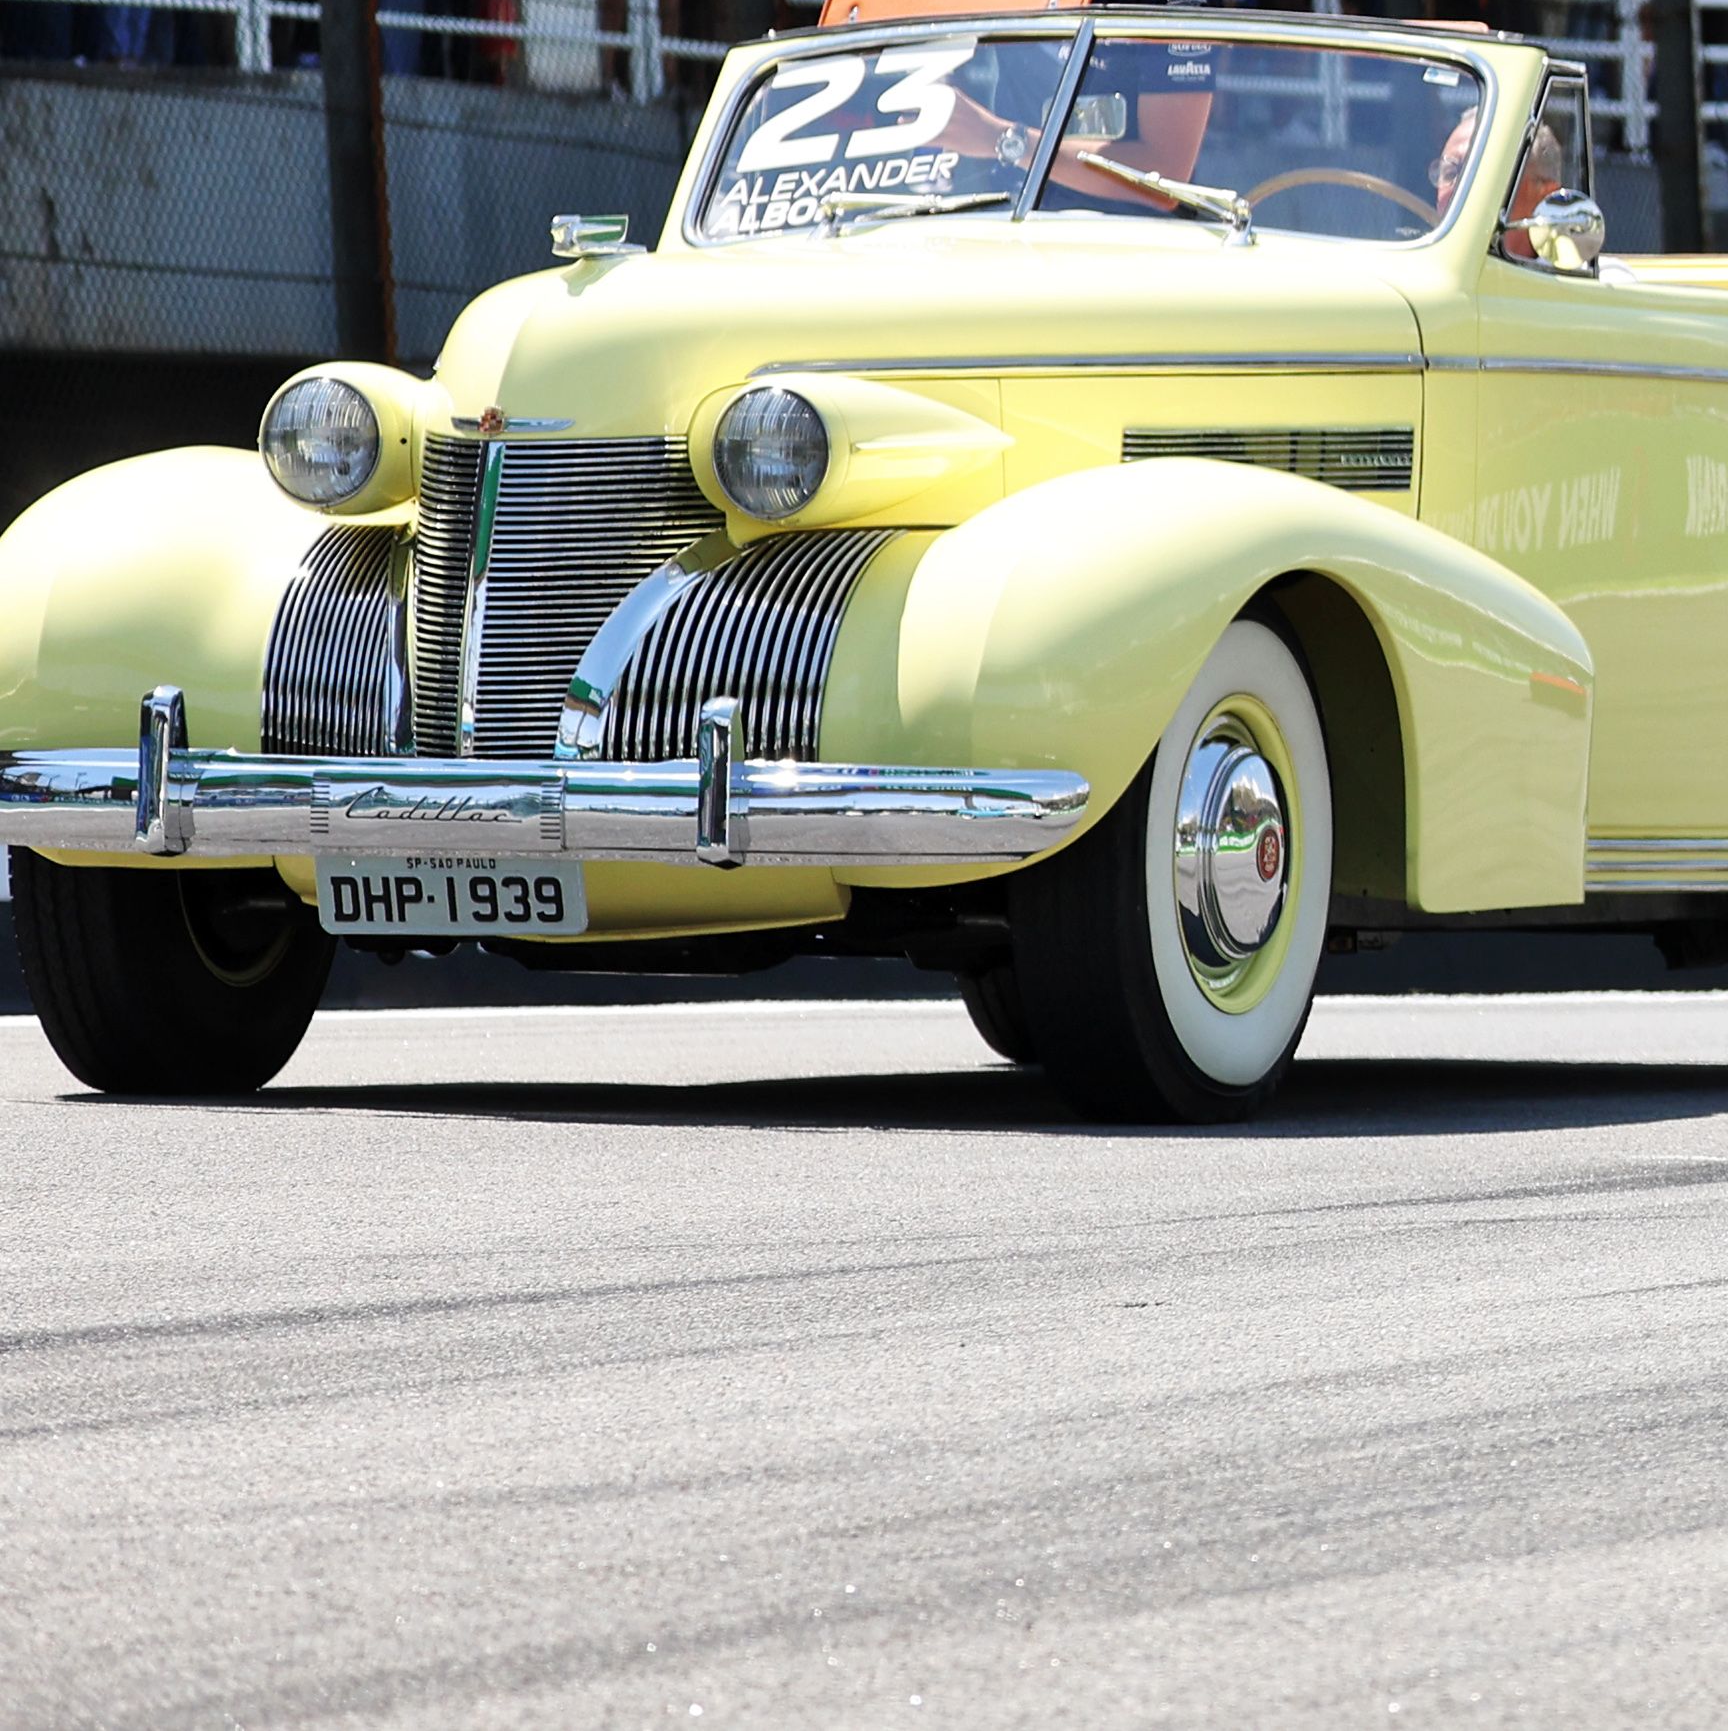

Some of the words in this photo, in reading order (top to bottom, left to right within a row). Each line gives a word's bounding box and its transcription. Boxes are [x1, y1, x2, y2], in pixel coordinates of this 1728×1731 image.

[737, 36, 978, 173] 23
[718, 151, 959, 207] ALEXANDER
[708, 196, 836, 236] ALBO
[345, 786, 522, 823] Cadillac
[456, 858, 496, 870] PAULO
